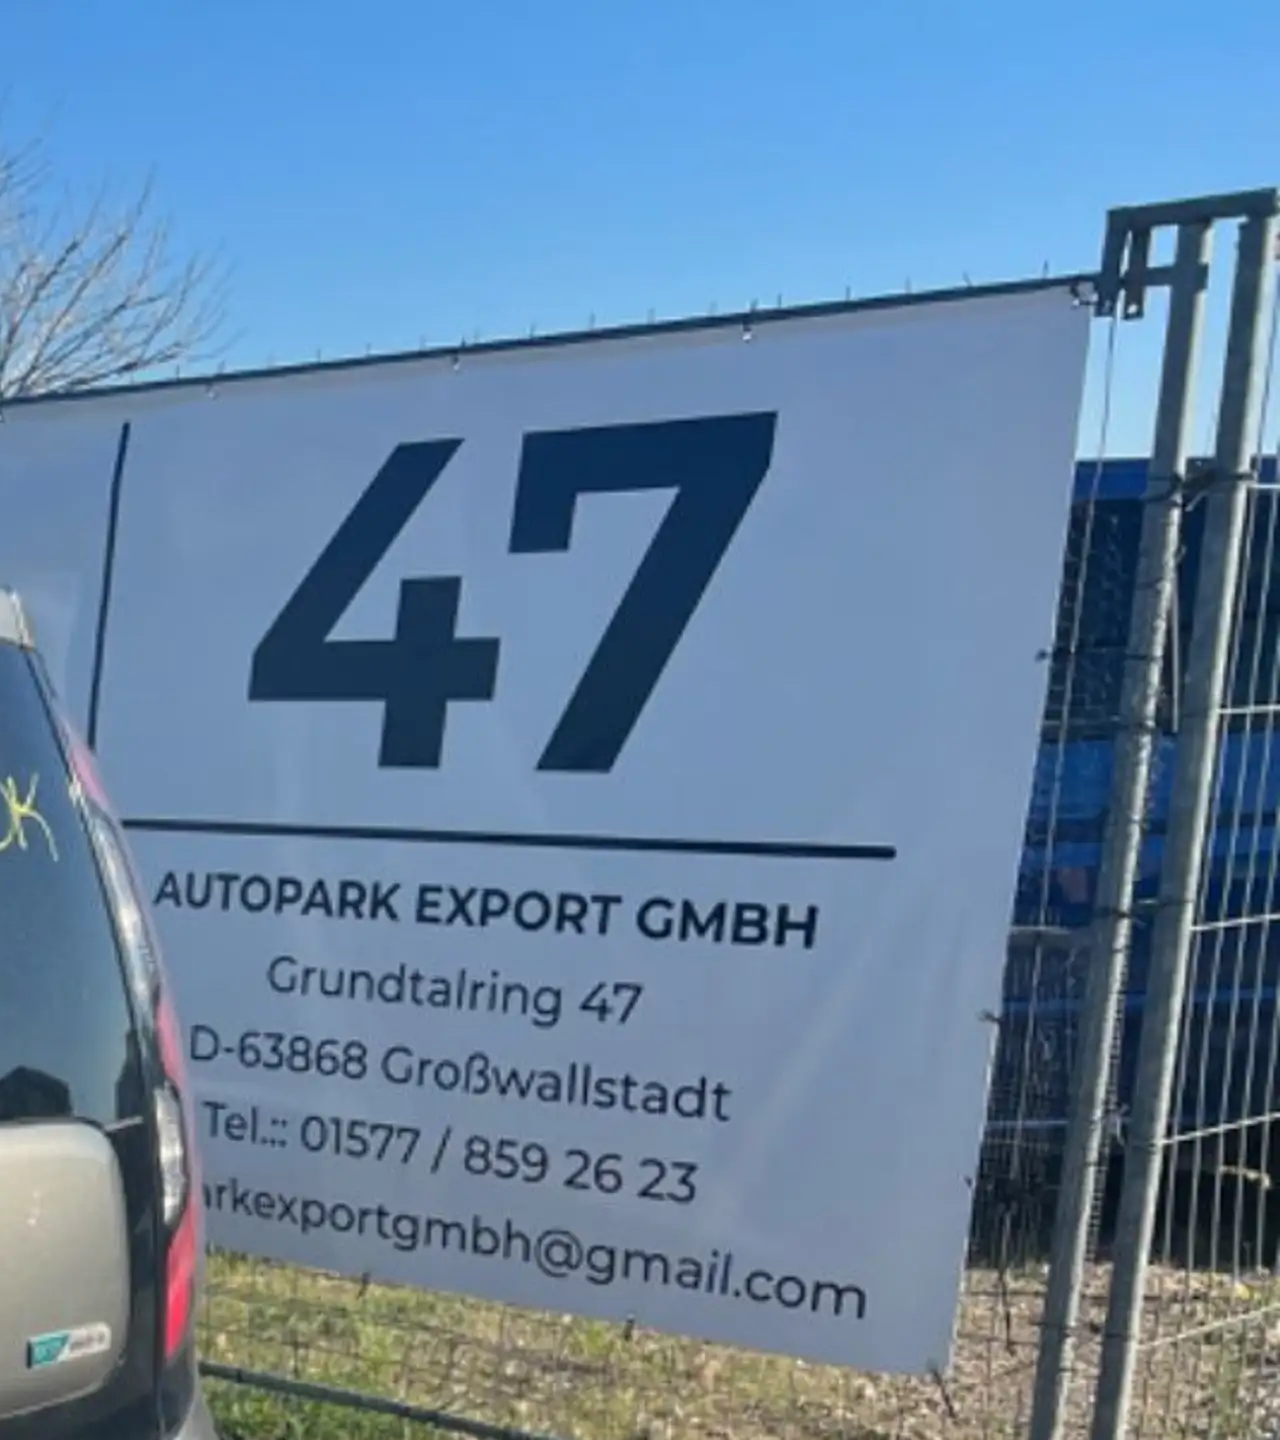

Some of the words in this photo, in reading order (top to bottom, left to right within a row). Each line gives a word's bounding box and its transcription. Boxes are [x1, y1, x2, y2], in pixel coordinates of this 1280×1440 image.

[248, 411, 777, 773] 47
[153, 871, 402, 922] AUTOPARK
[415, 884, 623, 936] EXPORT
[636, 896, 820, 950] GMBH
[267, 954, 563, 1029] Grundtalring
[578, 982, 644, 1025] 47
[189, 1024, 368, 1080] D-63868
[381, 1045, 732, 1123] Großwallstadt
[300, 1114, 422, 1166] 01577
[430, 1124, 453, 1174] /
[463, 1134, 550, 1184] 859
[562, 1148, 624, 1195] 26
[636, 1157, 700, 1204] 23
